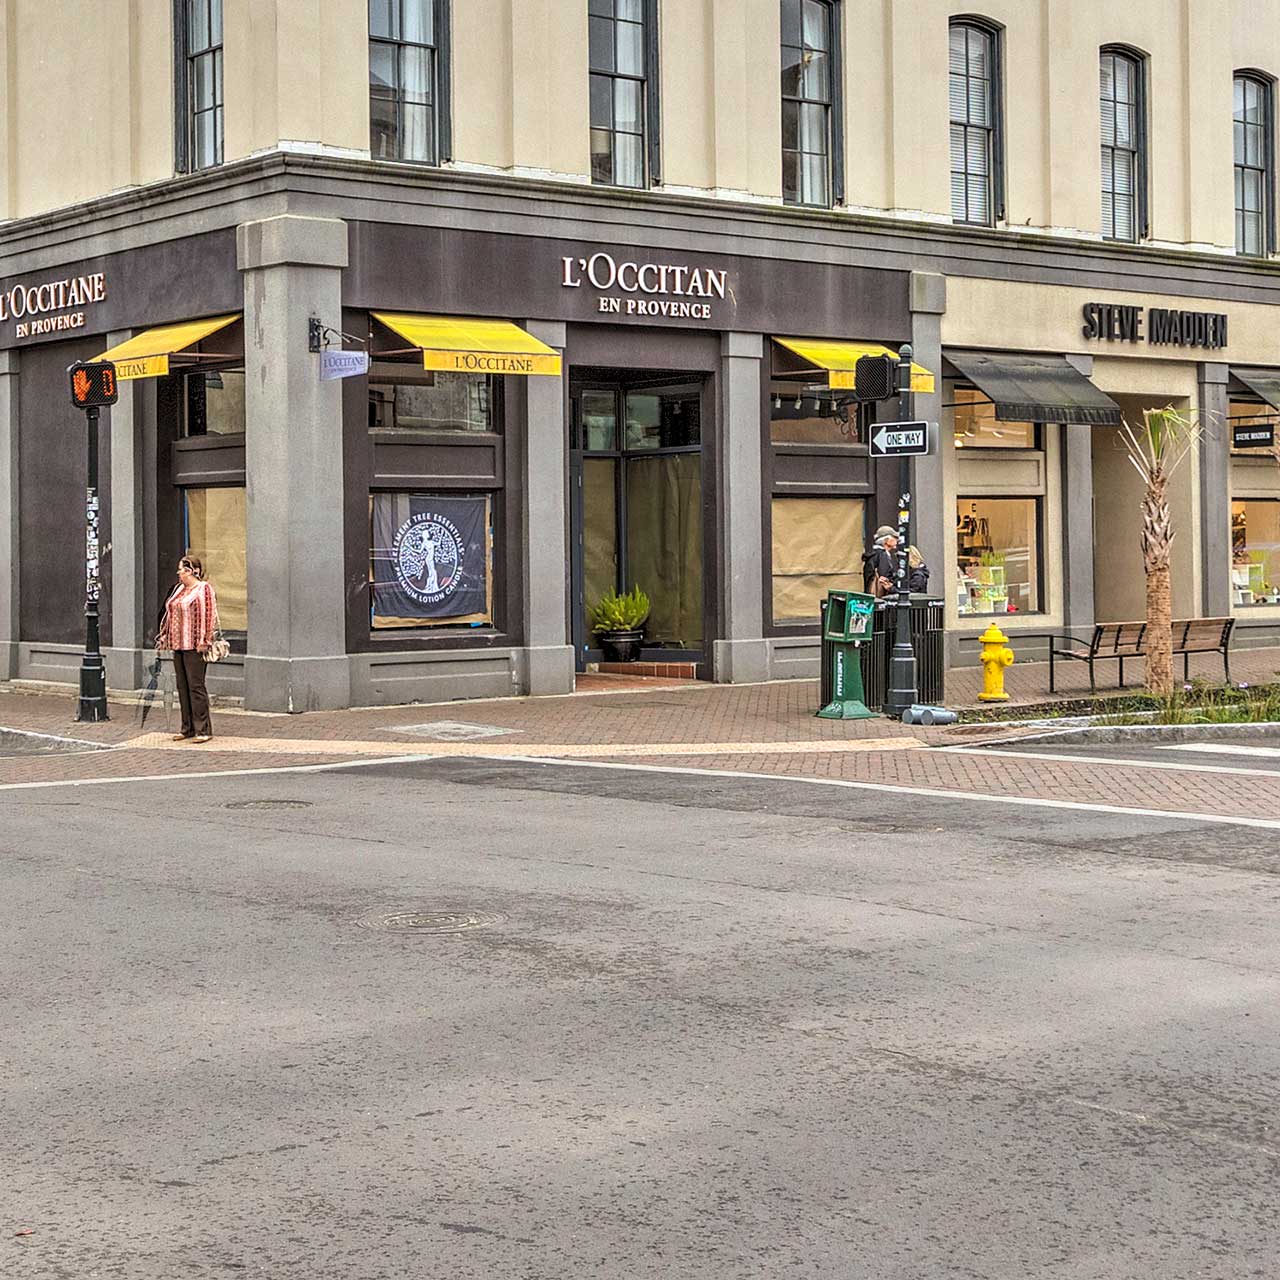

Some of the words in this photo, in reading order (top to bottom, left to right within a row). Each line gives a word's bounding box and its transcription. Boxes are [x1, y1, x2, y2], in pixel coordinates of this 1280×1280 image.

[562, 253, 727, 299] L'OCCITAN
[599, 297, 621, 312] EN
[627, 299, 711, 319] PROVENCE
[16, 324, 28, 338] EN
[31, 312, 84, 334] PROVENCE
[1083, 302, 1144, 341] STEVE
[1148, 308, 1227, 349] MADDEN
[455, 354, 533, 371] L'OCCITANE
[102, 370, 114, 396] 0
[886, 434, 902, 445] ONE
[904, 432, 920, 444] WAY
[392, 520, 412, 557] ELEMENT
[412, 513, 431, 523] TREE
[434, 514, 465, 552] ESSENTIALS
[394, 566, 417, 599] PREMIUM
[419, 593, 445, 604] LOTION
[446, 567, 463, 595] CANDLE
